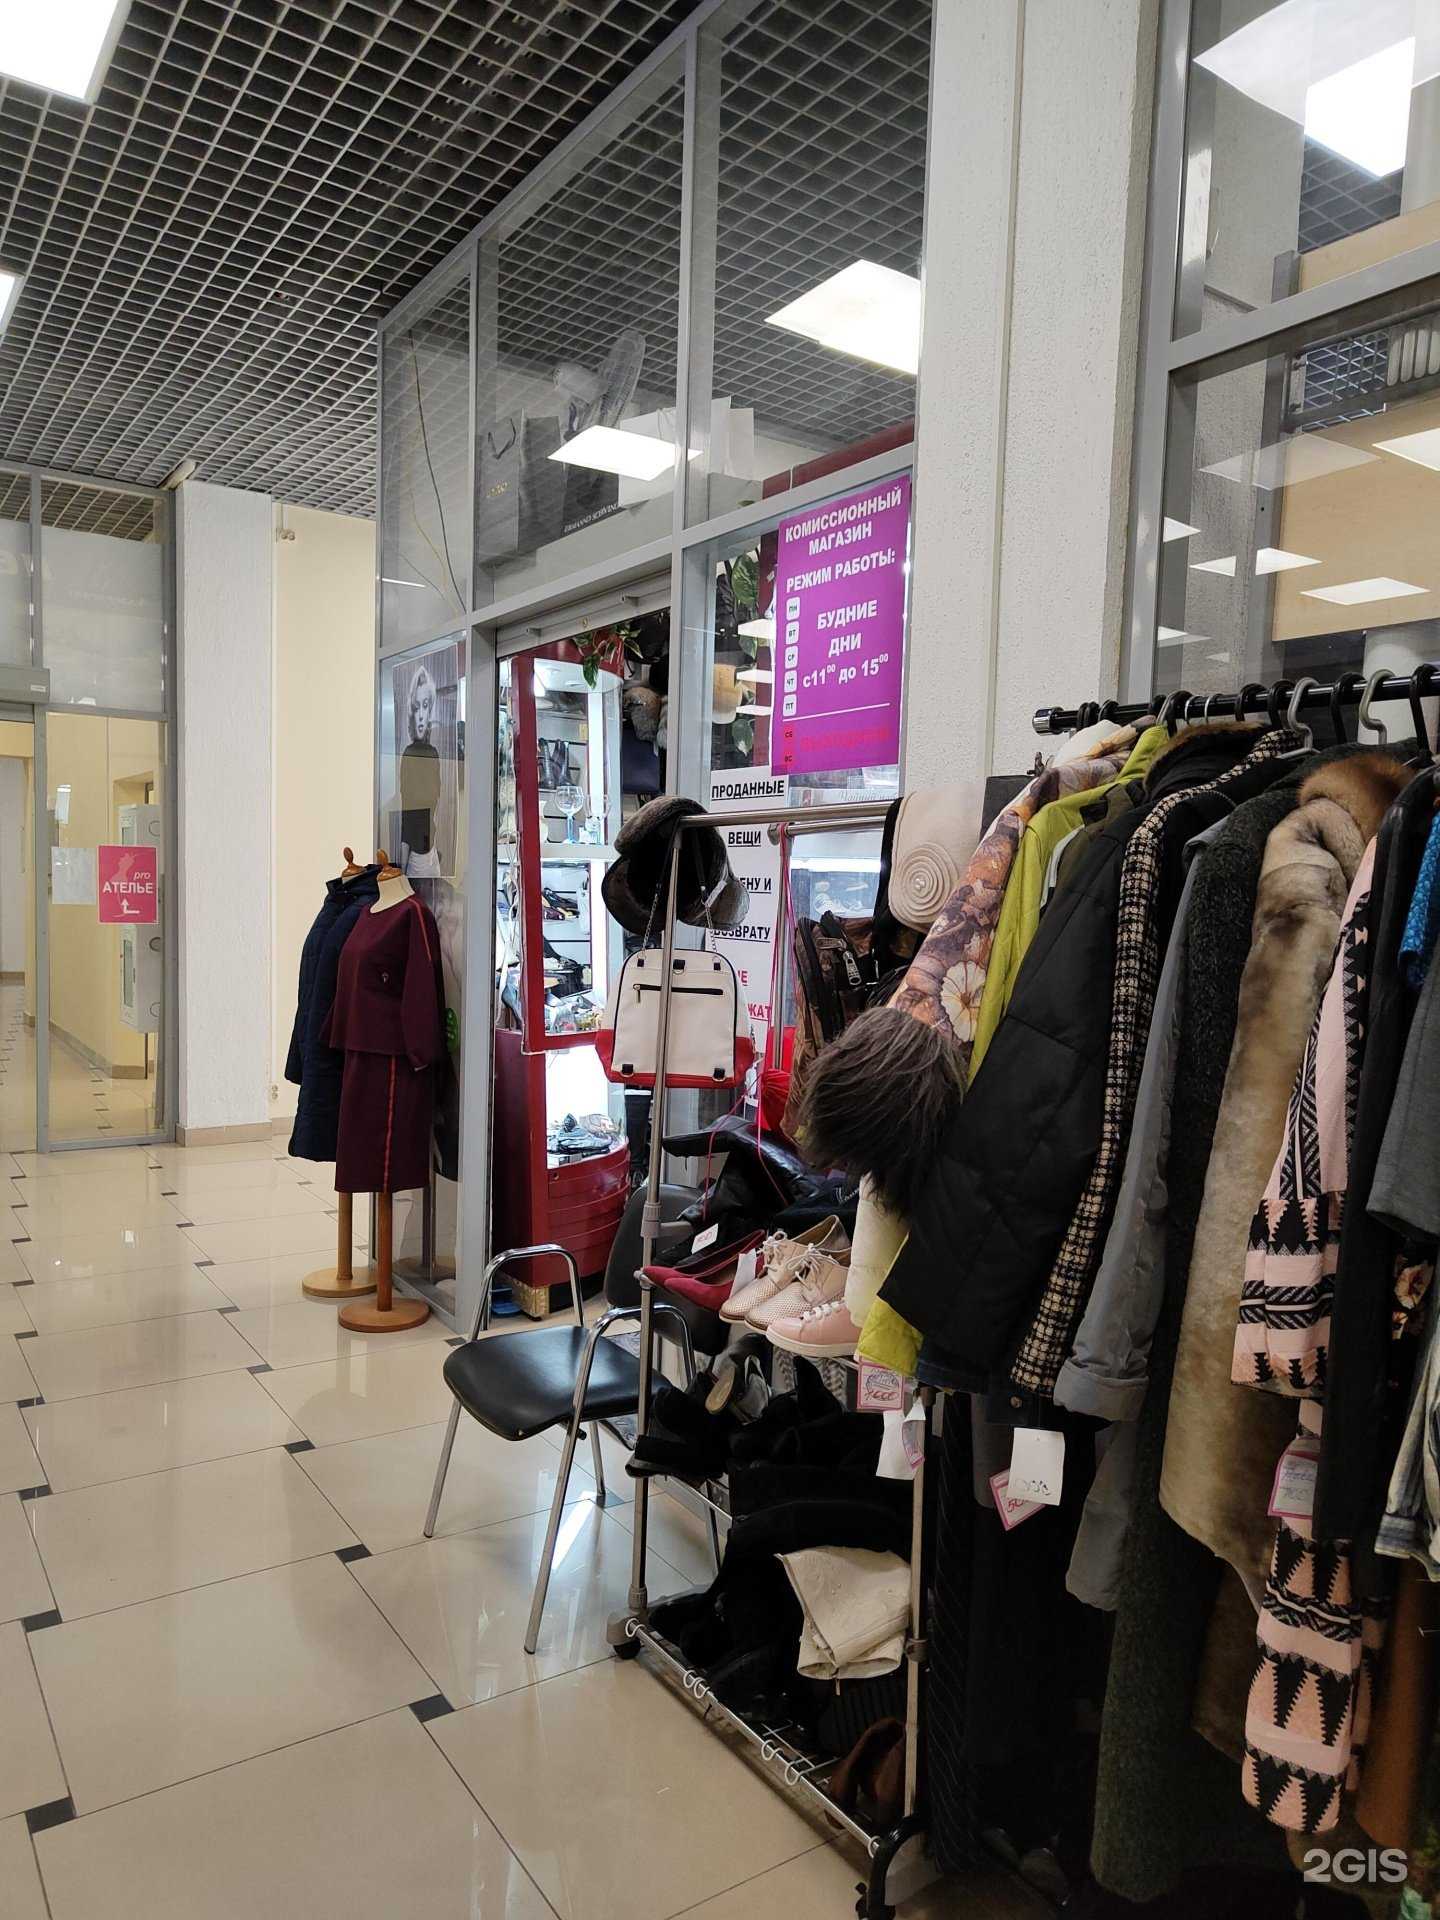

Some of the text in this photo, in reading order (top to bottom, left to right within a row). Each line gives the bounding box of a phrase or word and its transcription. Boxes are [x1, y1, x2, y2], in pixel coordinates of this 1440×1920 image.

[785, 486, 901, 543] КОМИССИОННЫЙ
[808, 521, 872, 555] МАГАЗИН
[786, 547, 896, 592] РЕЖИМ РАБОТЫ:
[817, 600, 878, 630] БУДНИЕ
[828, 632, 862, 658] ДНИ
[838, 667, 857, 684] до
[785, 702, 794, 710] ПТ
[711, 780, 785, 800] ПРОДАННЫЕ
[728, 831, 761, 846] ВЕЩИ
[102, 881, 153, 894] АТЕЛЬЕ
[764, 878, 772, 891] И
